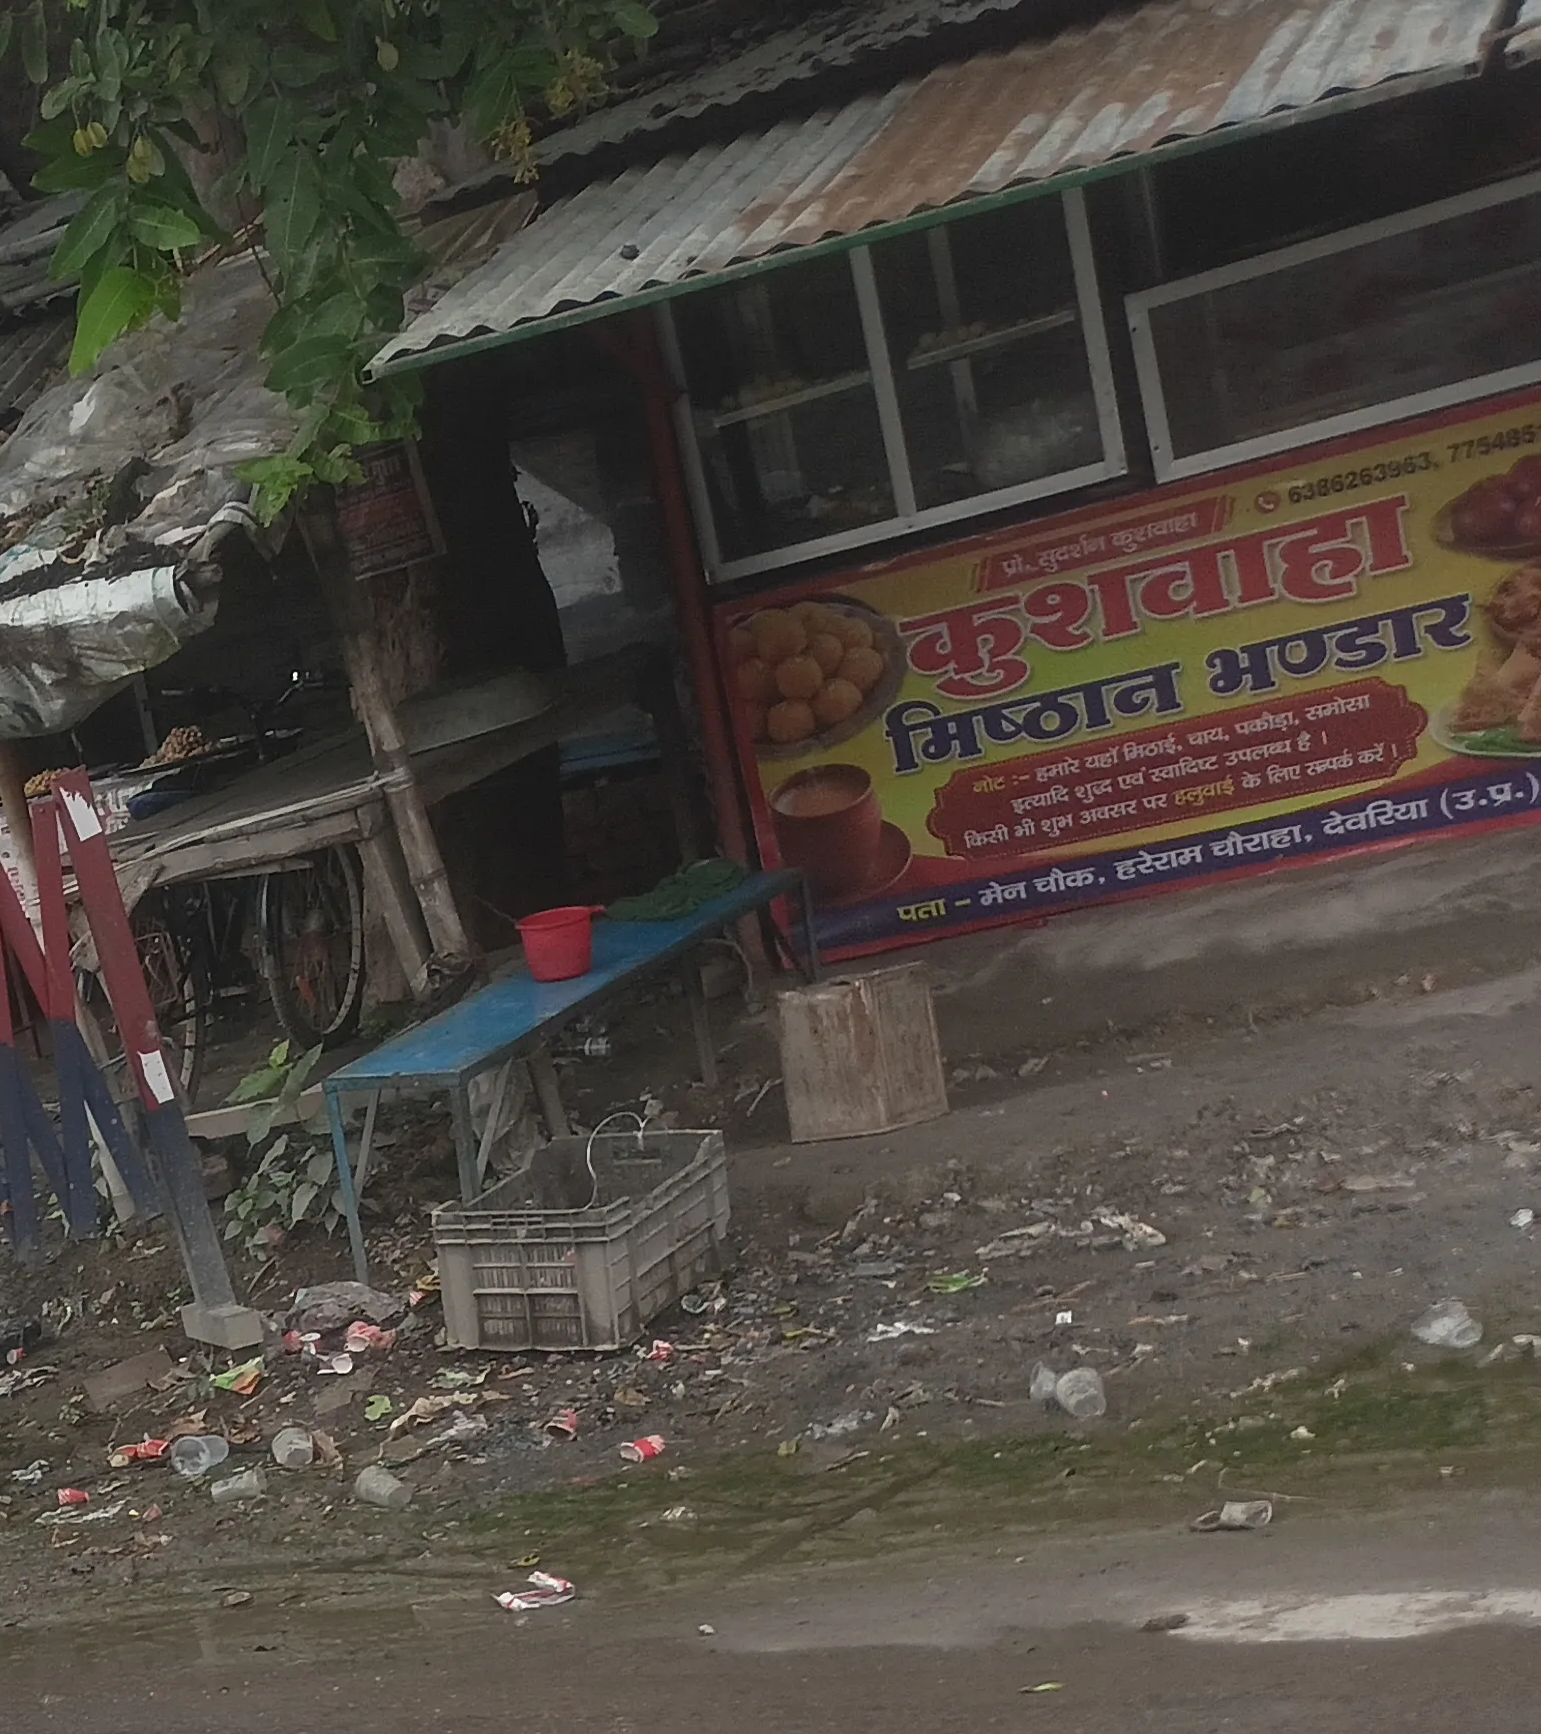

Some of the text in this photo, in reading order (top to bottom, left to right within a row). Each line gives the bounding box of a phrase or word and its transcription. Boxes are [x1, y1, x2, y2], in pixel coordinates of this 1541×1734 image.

[1288, 451, 1440, 505] 6386263963,
[1038, 537, 1106, 574] सुदर्शन
[1112, 511, 1199, 553] कुशवाहा
[899, 495, 1411, 699] कुशवाहा
[884, 593, 1474, 776] मिष्ठान भण्डार
[973, 775, 1005, 793] नोट
[1036, 757, 1080, 782] हमारे
[1123, 732, 1183, 762] मिठाई,
[1186, 727, 1229, 746] चाय,
[1306, 694, 1370, 720] समोसा
[1011, 785, 1069, 815] इत्यादि
[1119, 766, 1146, 790] एवं
[1149, 755, 1218, 783] स्वादिष्ट
[1224, 737, 1291, 767] उपलब्ध
[1297, 731, 1311, 751] है
[897, 898, 946, 922] पता
[978, 880, 1026, 907] मेन
[1033, 867, 1106, 895] चौक,
[1114, 843, 1204, 881] हरेराम
[1209, 824, 1312, 858] चौराहा,
[1321, 798, 1429, 835] देवरिया
[1440, 771, 1540, 819] (उ.प्र.)
[964, 824, 1009, 850] किसी
[1015, 819, 1035, 838] भी
[1041, 812, 1073, 838] शुभ
[1080, 799, 1137, 826] अवसर
[1142, 793, 1168, 810] पर
[1241, 771, 1261, 790] के
[1266, 764, 1301, 785] लिए
[1358, 742, 1385, 765] करें
